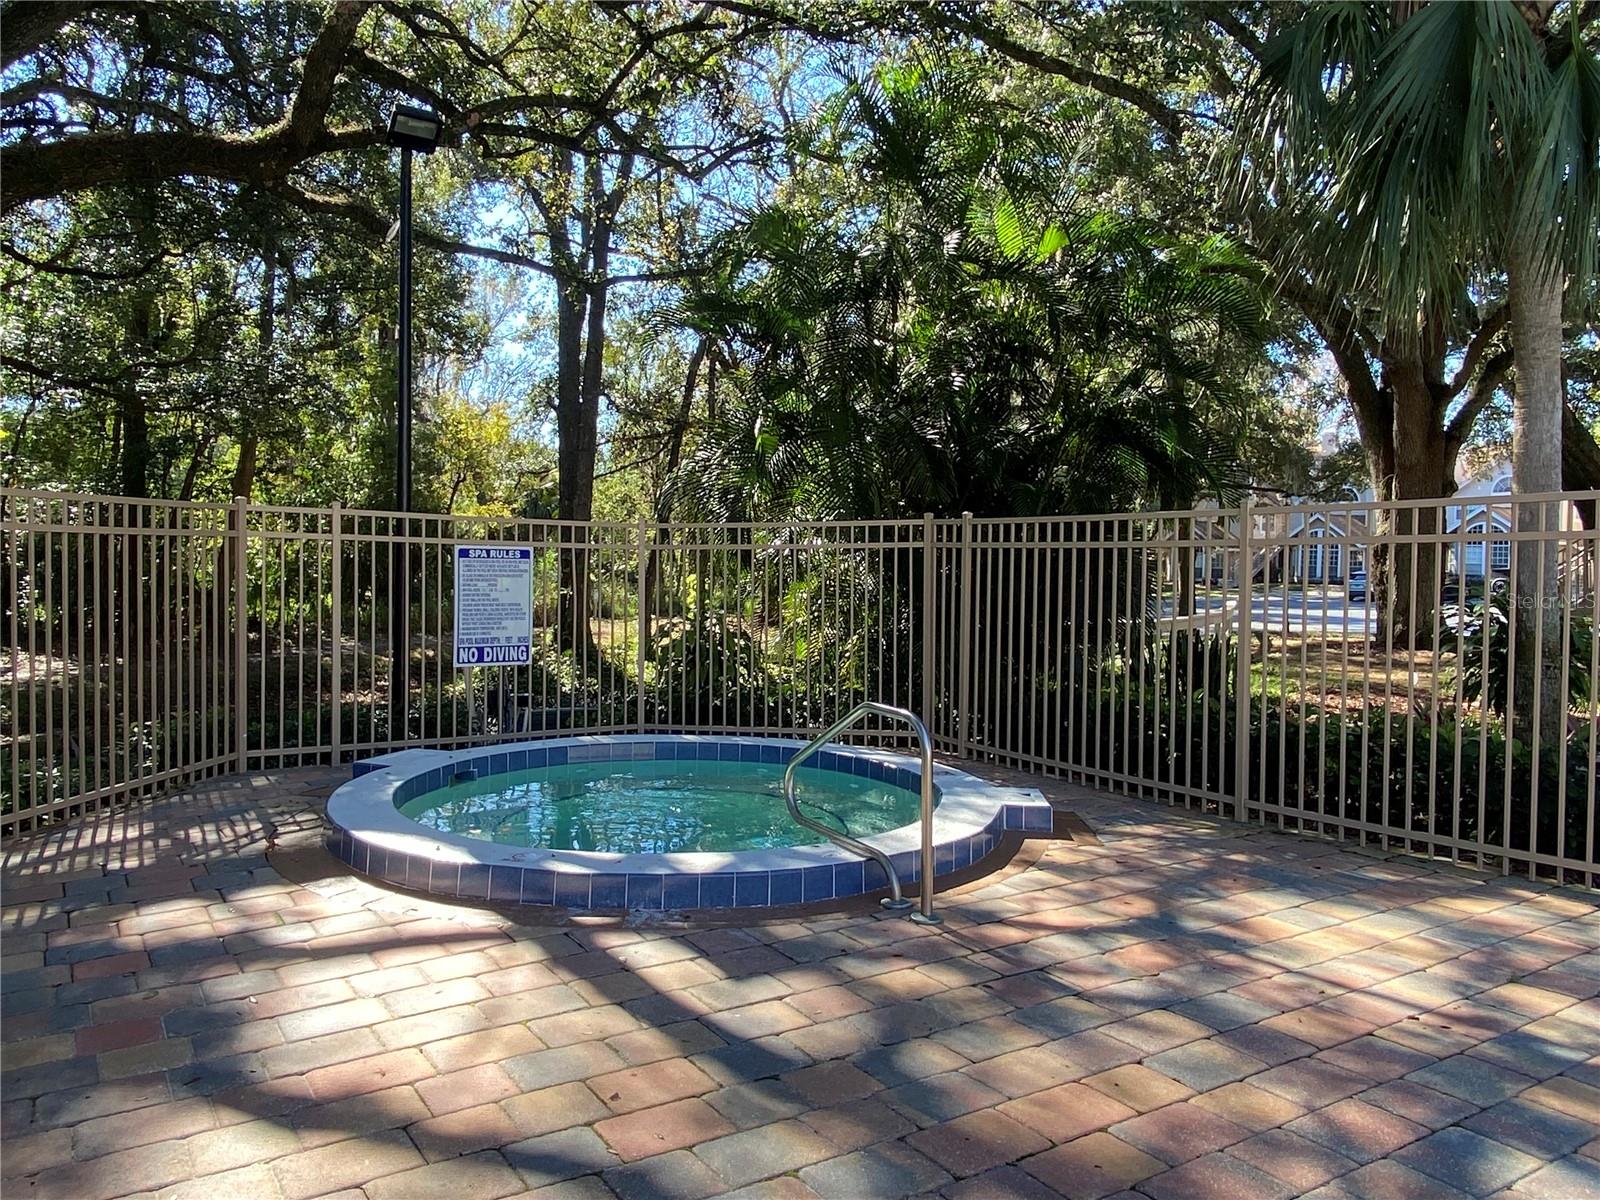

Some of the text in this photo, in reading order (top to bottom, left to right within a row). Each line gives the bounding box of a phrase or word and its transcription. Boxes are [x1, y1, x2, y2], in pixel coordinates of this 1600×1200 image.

[468, 549, 521, 559] SPA RULES
[459, 645, 527, 663] NO DIVING
